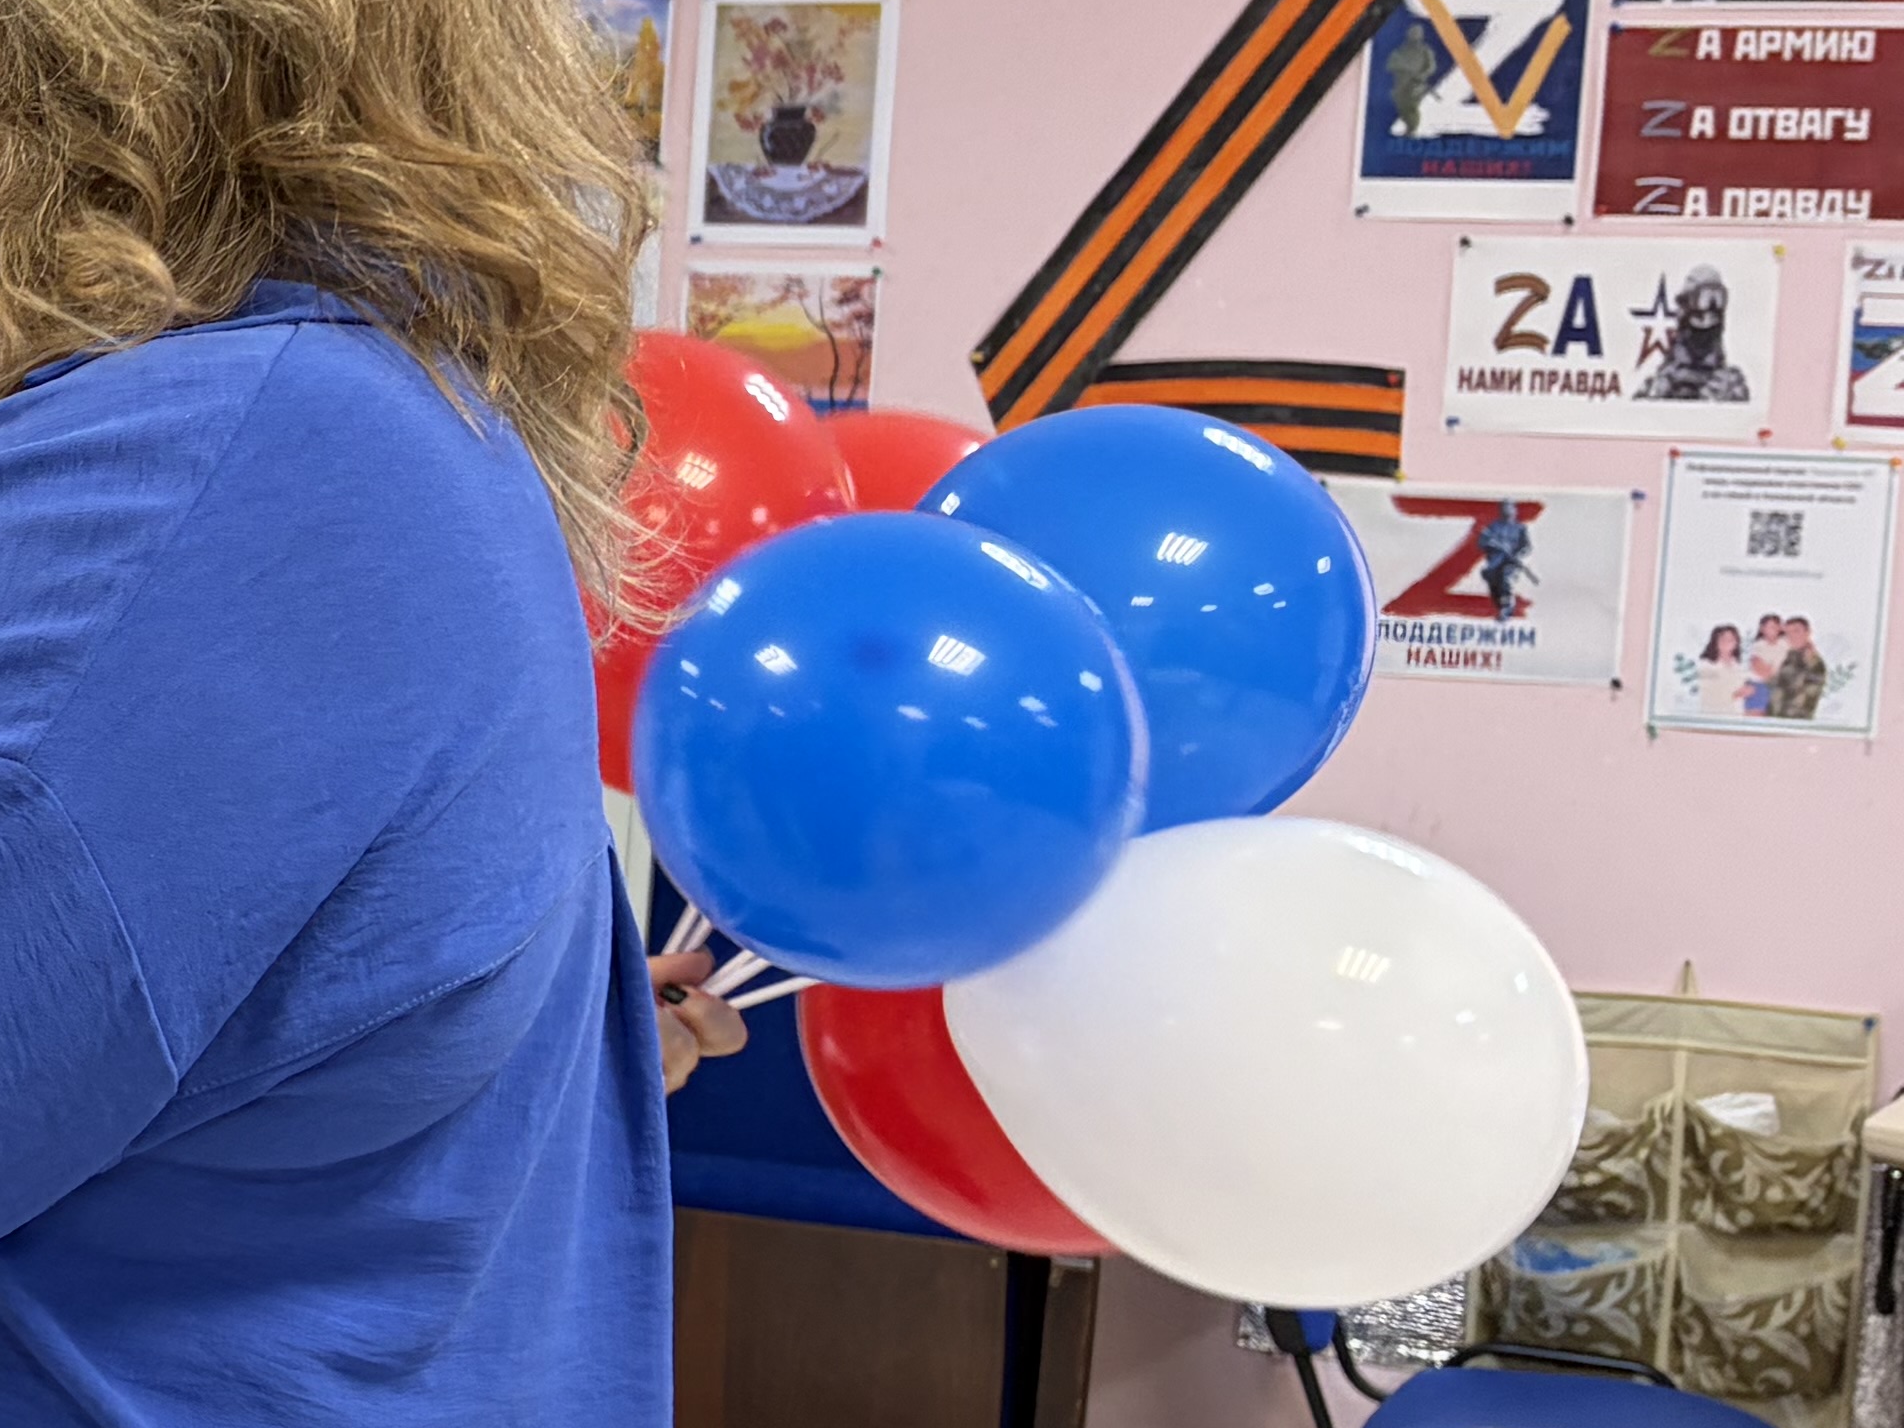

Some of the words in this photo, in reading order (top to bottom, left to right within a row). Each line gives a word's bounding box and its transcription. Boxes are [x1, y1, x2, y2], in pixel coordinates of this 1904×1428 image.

[1733, 28, 1878, 62] АРМИЮ
[1727, 106, 1872, 141] ОТВАГУ
[1721, 187, 1873, 220] ПРАВДУ
[1457, 366, 1523, 393] НАМИ
[1529, 370, 1622, 401] ПРАВДА
[1377, 619, 1537, 648] ПОДДЕРЖИМ
[1405, 647, 1504, 671] НАШИХ!
